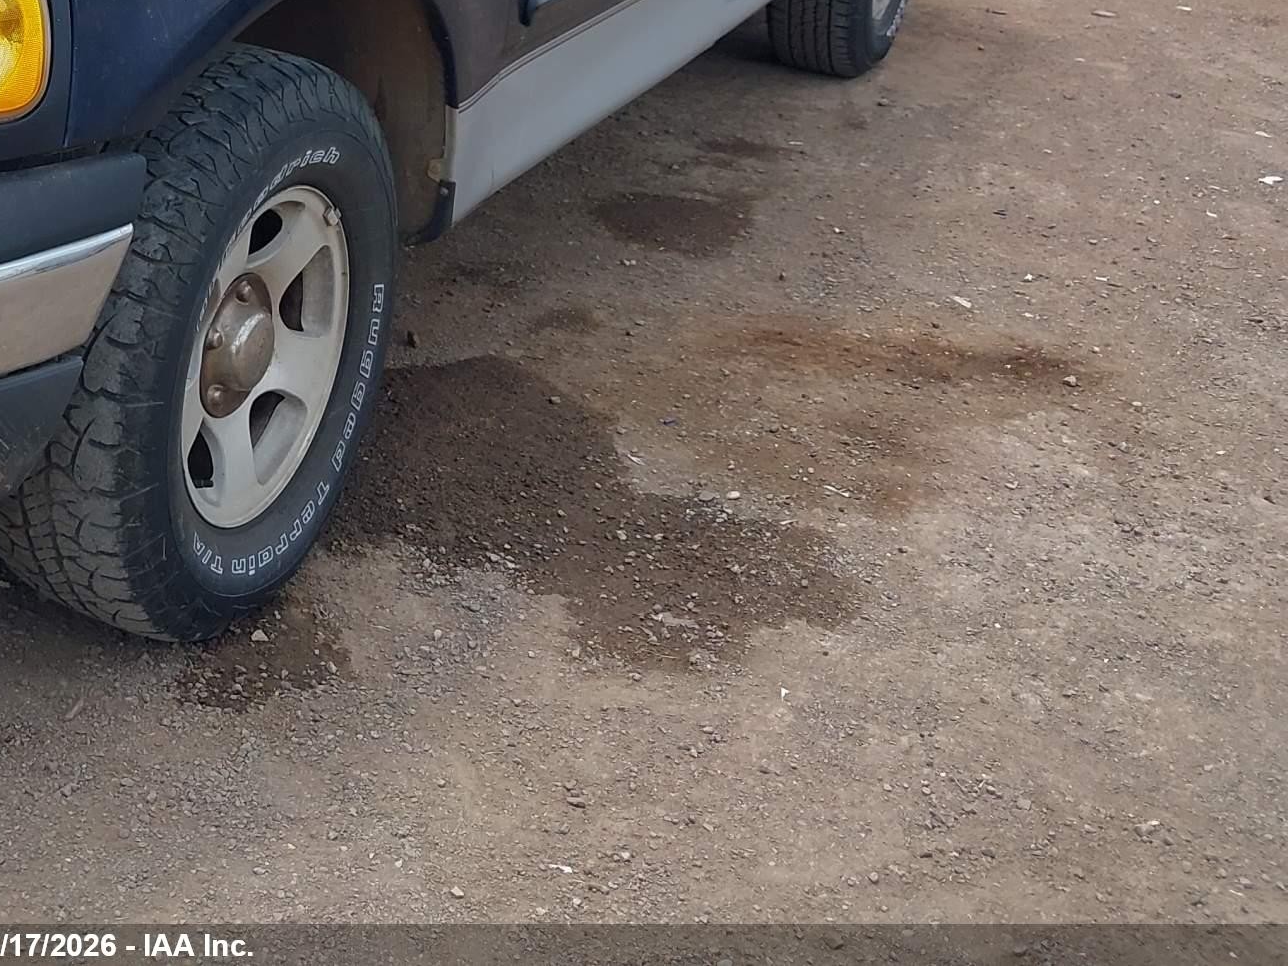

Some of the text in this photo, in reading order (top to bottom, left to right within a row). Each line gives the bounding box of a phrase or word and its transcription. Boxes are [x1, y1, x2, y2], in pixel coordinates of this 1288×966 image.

[193, 283, 385, 575] Rugged Terrain T/A
